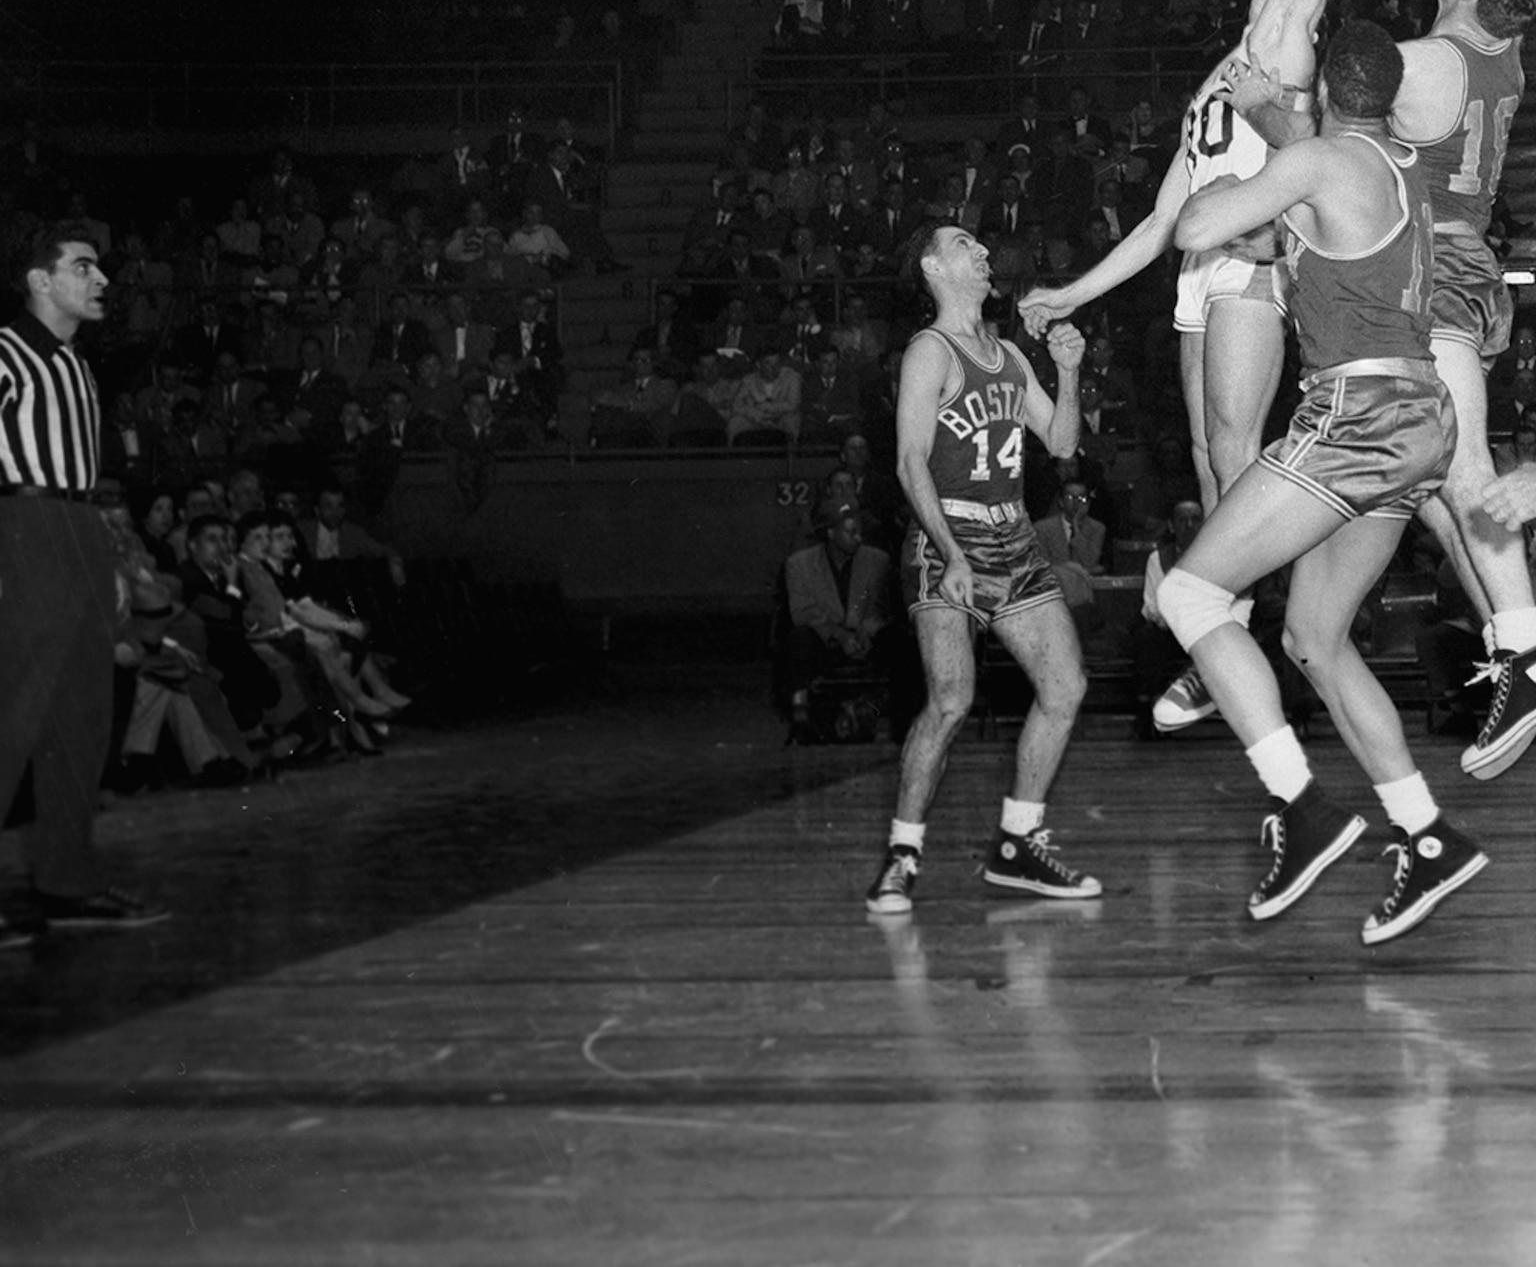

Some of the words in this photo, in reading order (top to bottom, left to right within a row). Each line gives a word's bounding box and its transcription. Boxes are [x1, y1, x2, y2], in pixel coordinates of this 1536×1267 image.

[938, 383, 1027, 440] BOSTO
[969, 427, 1024, 481] 14
[777, 482, 809, 506] 32
